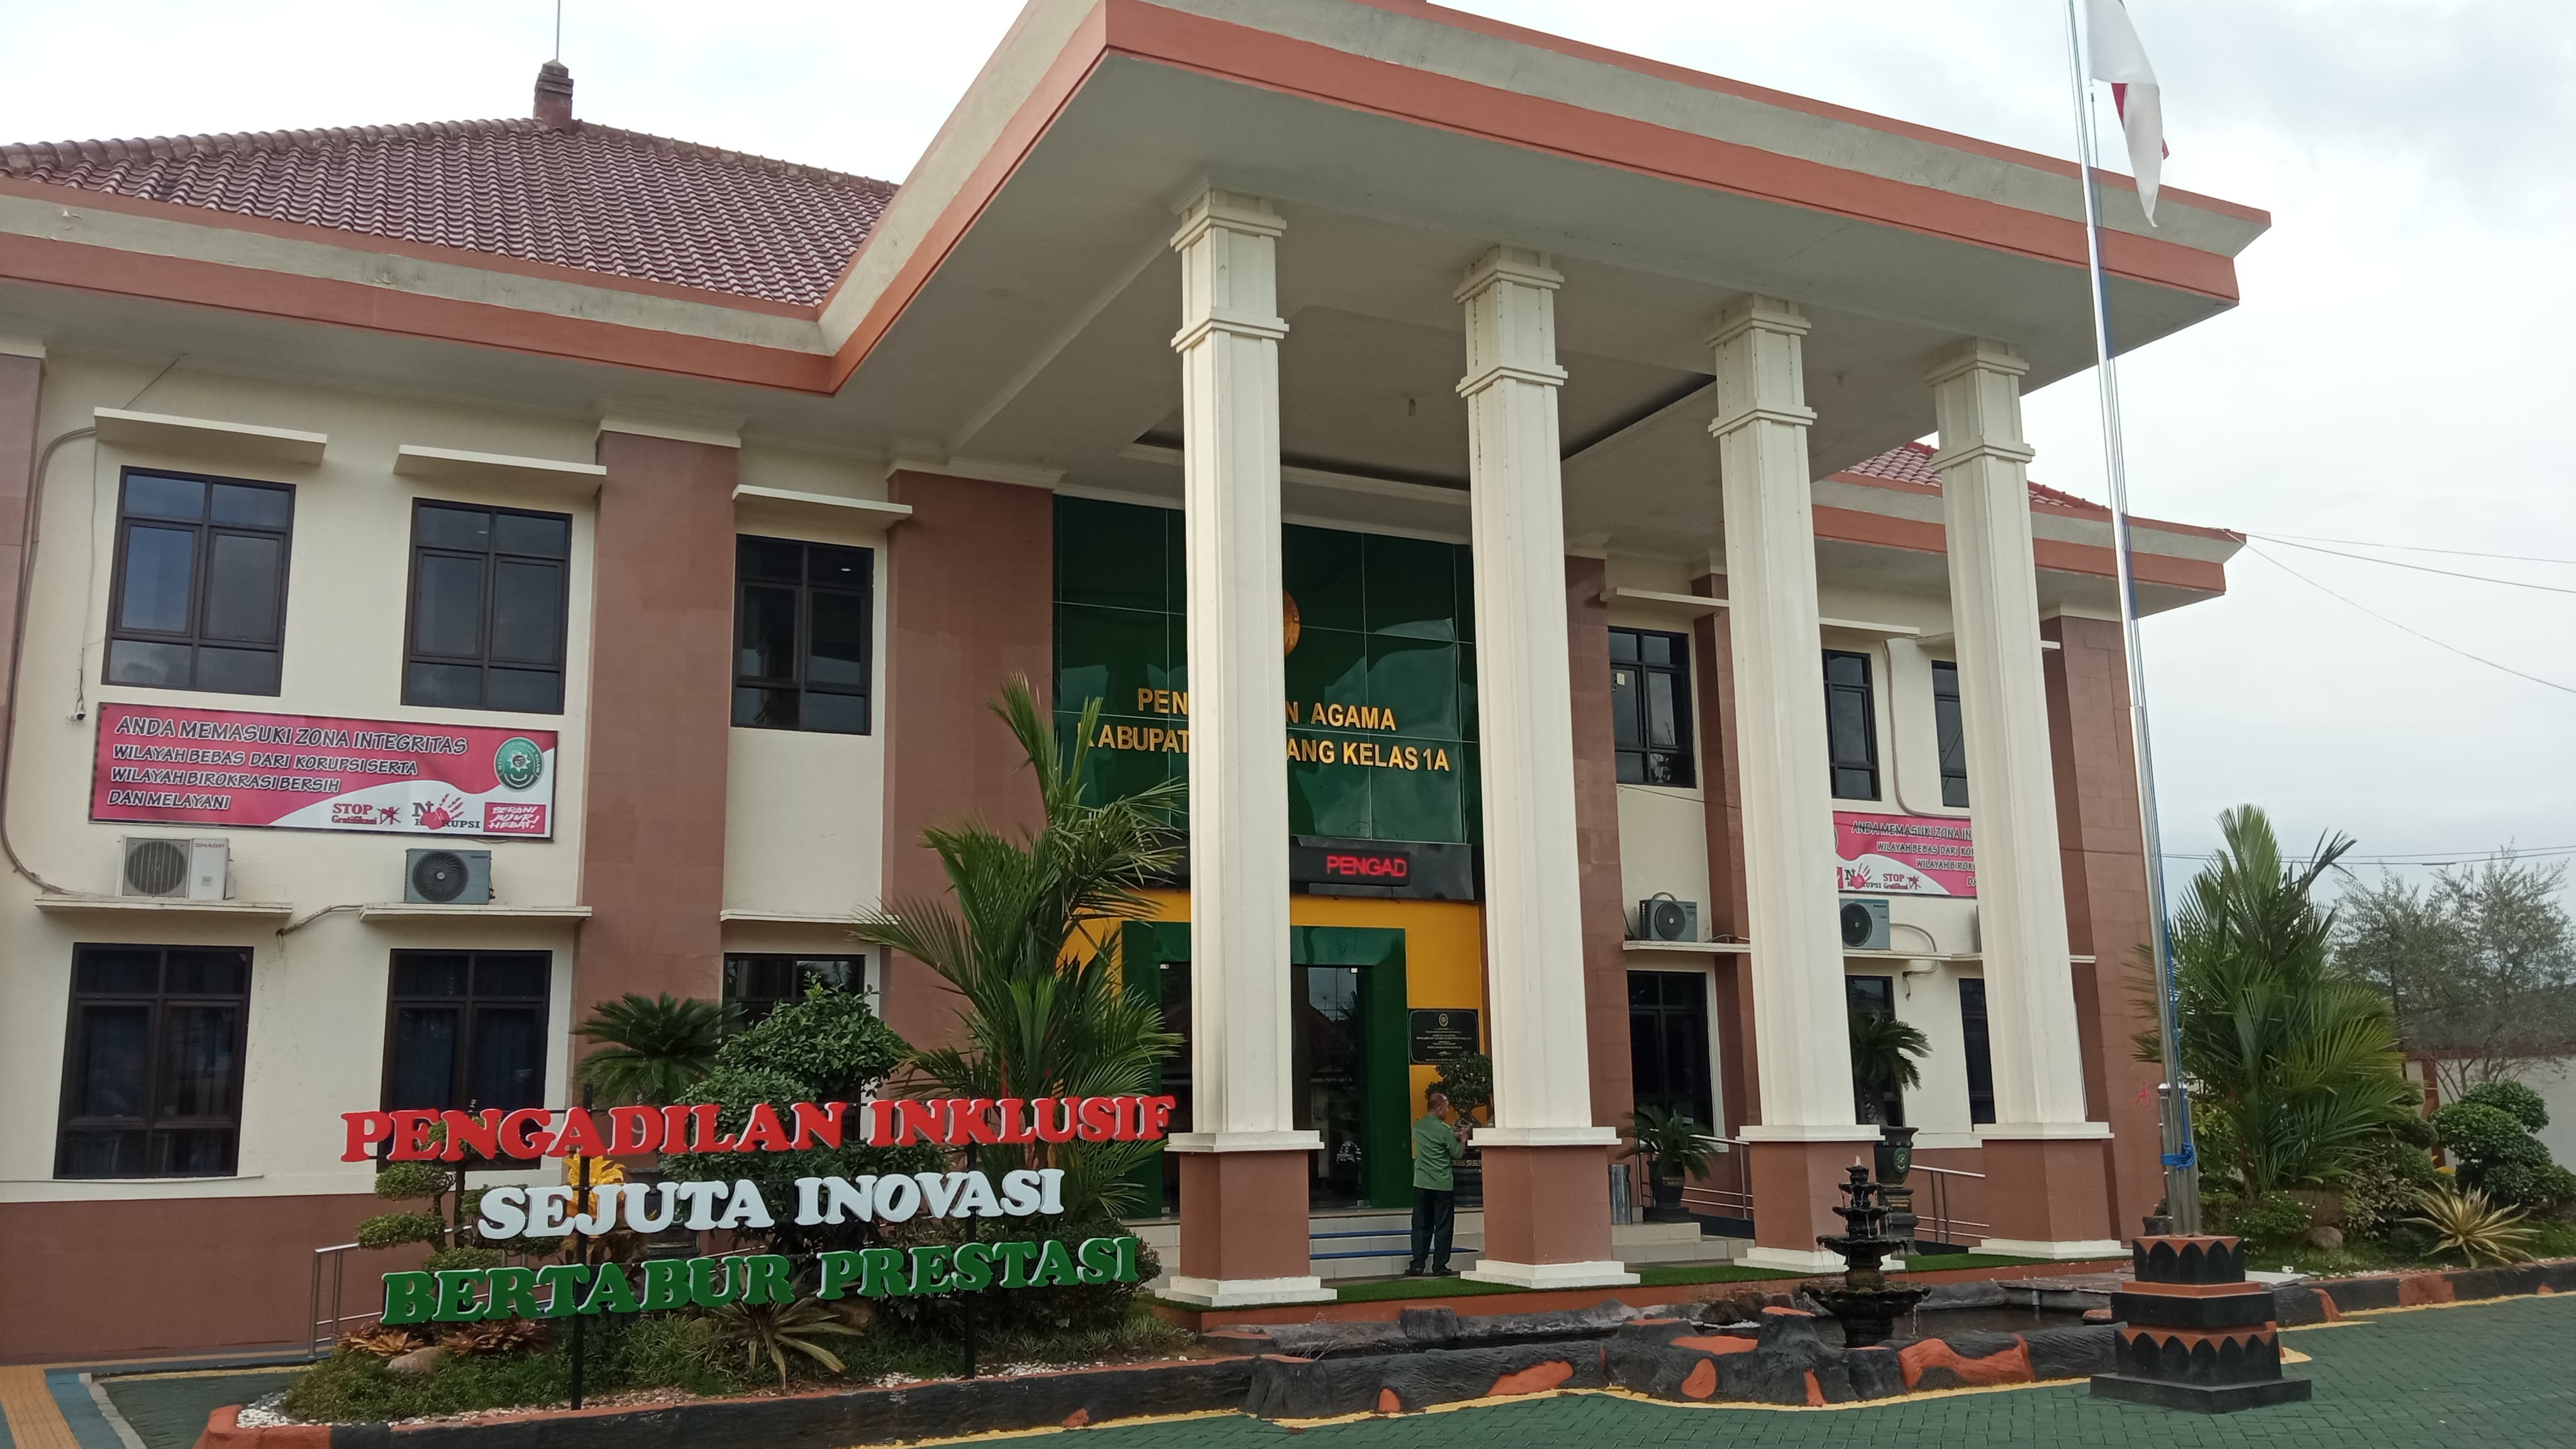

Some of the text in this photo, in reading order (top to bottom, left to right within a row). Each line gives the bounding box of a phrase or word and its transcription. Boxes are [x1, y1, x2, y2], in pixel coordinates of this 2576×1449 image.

[1311, 702, 1396, 731] AGAMA
[115, 716, 468, 755] ANDA MEMASUKI ZONA INTEGRITAS
[113, 744, 418, 775] WILAYAH BEBAS DARI KORUPSI SERTA
[1343, 741, 1419, 770] KELAS
[1423, 748, 1450, 771] 1A
[111, 767, 341, 793] WILAYAH BIROKRASI BERSIH
[108, 789, 231, 810] DAN MELAYANI
[332, 802, 374, 815] STOP
[414, 818, 481, 828] KRUPSI
[1851, 821, 1880, 835] ANDA
[1880, 824, 1933, 838] MEMASUKI
[1934, 826, 1961, 840] ZONA
[1877, 841, 1911, 853] WILAYAH
[1912, 843, 1938, 854] BEBAS
[1940, 845, 1958, 855] DARI
[1326, 855, 1408, 877] PENGAD
[1916, 858, 1948, 870] WILAYAH
[1883, 873, 1904, 882] STOP
[340, 1095, 1176, 1163] PENGADILAN INKLUSIF
[478, 1169, 1065, 1240] SEJUTA INOVASI
[380, 1235, 1140, 1325] BERTABUR PRESTASI
